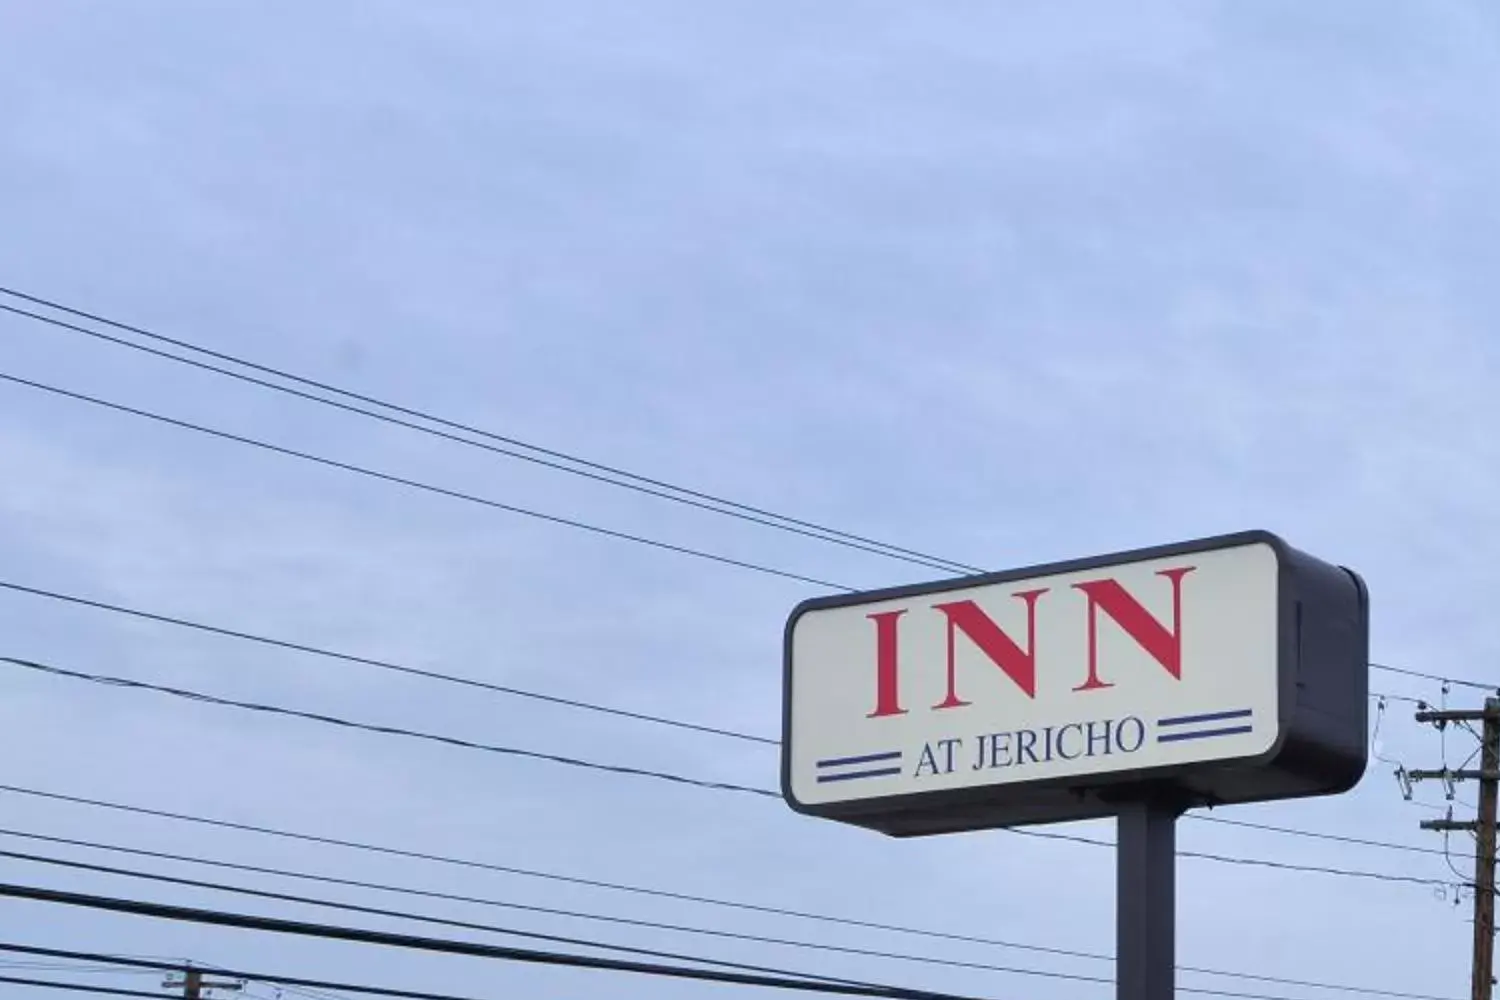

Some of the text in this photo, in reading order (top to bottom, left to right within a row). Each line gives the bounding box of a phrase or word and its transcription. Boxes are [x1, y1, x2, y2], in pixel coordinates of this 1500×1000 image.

[866, 566, 1197, 718] INN
[913, 715, 1145, 778] AT JERICHO
